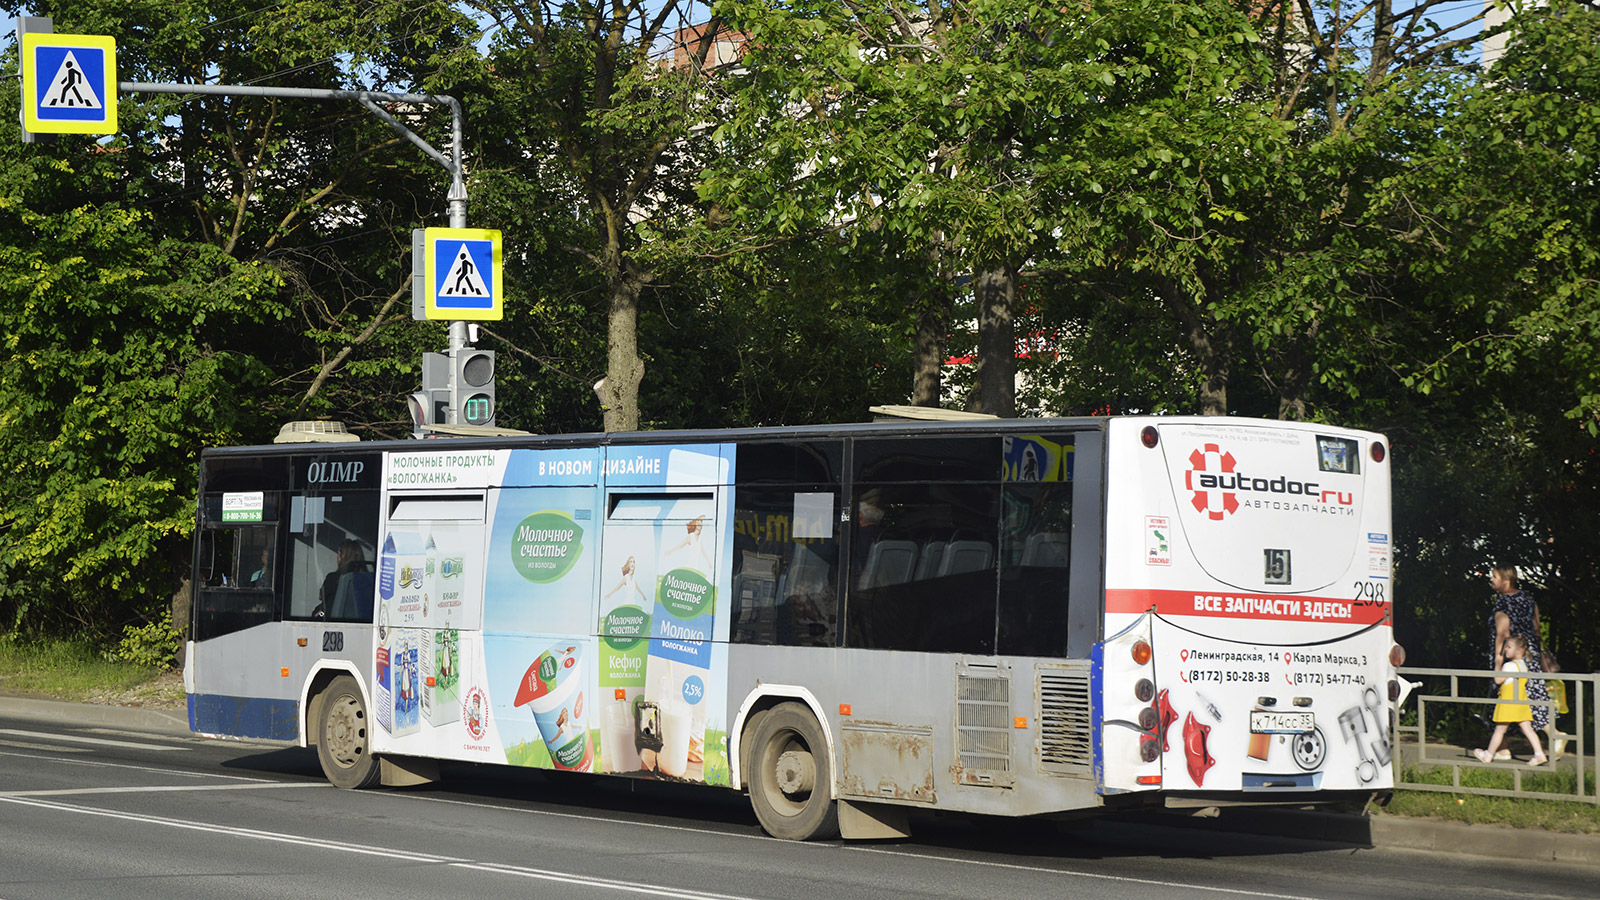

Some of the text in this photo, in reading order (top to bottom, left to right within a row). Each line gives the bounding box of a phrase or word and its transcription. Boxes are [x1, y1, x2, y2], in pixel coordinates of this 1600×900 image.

[467, 398, 489, 420] 07
[393, 455, 496, 469] МОЛОЧНЫЕ ПРОДУКТЫ
[539, 456, 661, 477] В НОВОМ ДИЗАЙНЕ
[307, 461, 365, 483] OLIMP
[388, 472, 458, 484] «ВОЛОГЖАНКА»
[1200, 472, 1353, 506] autodoc.ru
[1244, 499, 1354, 516] АВТОЗАПЧАСТИ
[517, 526, 574, 543] Молочное
[520, 543, 568, 558] счастье
[1264, 550, 1286, 580] 15
[665, 575, 707, 595] Молочное
[666, 588, 702, 604] счастье
[1353, 582, 1385, 608] 298
[1194, 595, 1352, 619] ВСЕ ЗАПЧАСТИ ЗДЕСЬ!
[608, 615, 644, 625] Молочное
[609, 625, 640, 635] счастье
[660, 620, 704, 646] Молоко
[322, 631, 344, 651] 298
[661, 640, 698, 656] ВОЛОГЖАНКА
[609, 653, 642, 672] Кефир
[1190, 650, 1279, 664] Ленинградская, 14
[1293, 652, 1368, 667] Карла Маркса, 3
[1188, 670, 1270, 684] (8172) 50-28-38
[1293, 672, 1366, 687] (8172) 54-77-40
[684, 682, 702, 697] 2,5%
